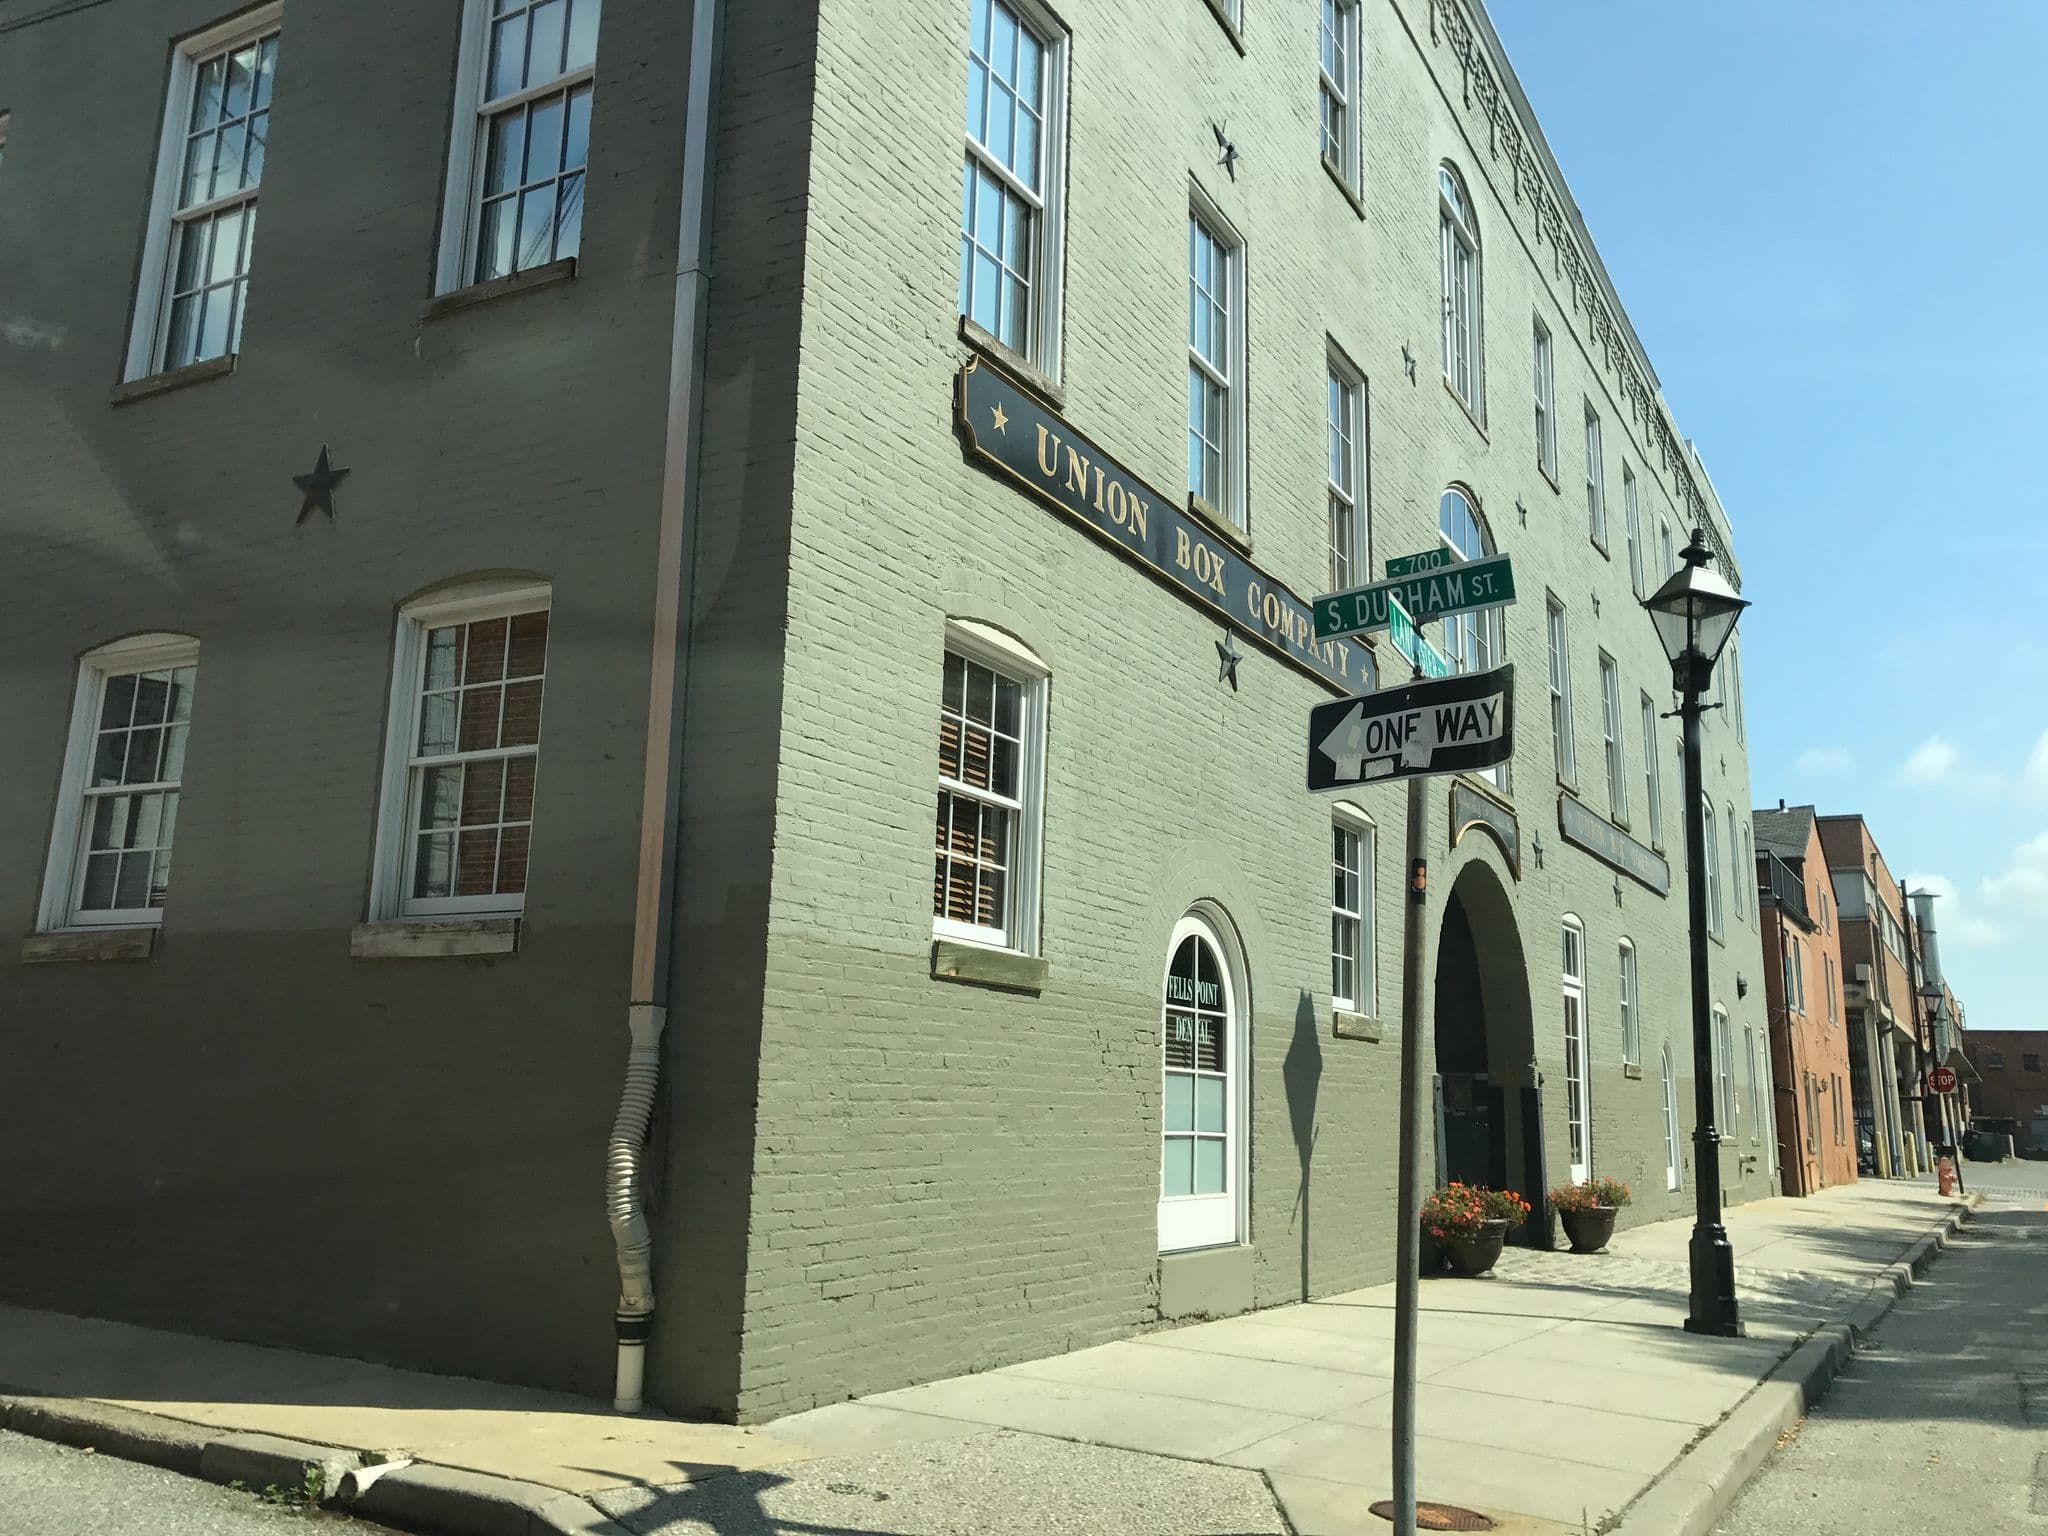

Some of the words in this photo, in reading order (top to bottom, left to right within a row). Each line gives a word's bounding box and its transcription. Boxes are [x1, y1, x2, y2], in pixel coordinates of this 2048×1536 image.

[1035, 422, 1150, 543] UNION
[1175, 526, 1227, 597] BOX
[1246, 581, 1350, 677] COMPANY
[1407, 551, 1442, 574] 700
[1327, 600, 1349, 632] S.
[1471, 572, 1499, 597] ST.
[1435, 698, 1499, 744] WAY
[1168, 975, 1193, 1001] FELLS
[1196, 980, 1219, 1006] POINT
[1175, 1016, 1211, 1044] DENAL
[1929, 1074, 1954, 1086] STOP
